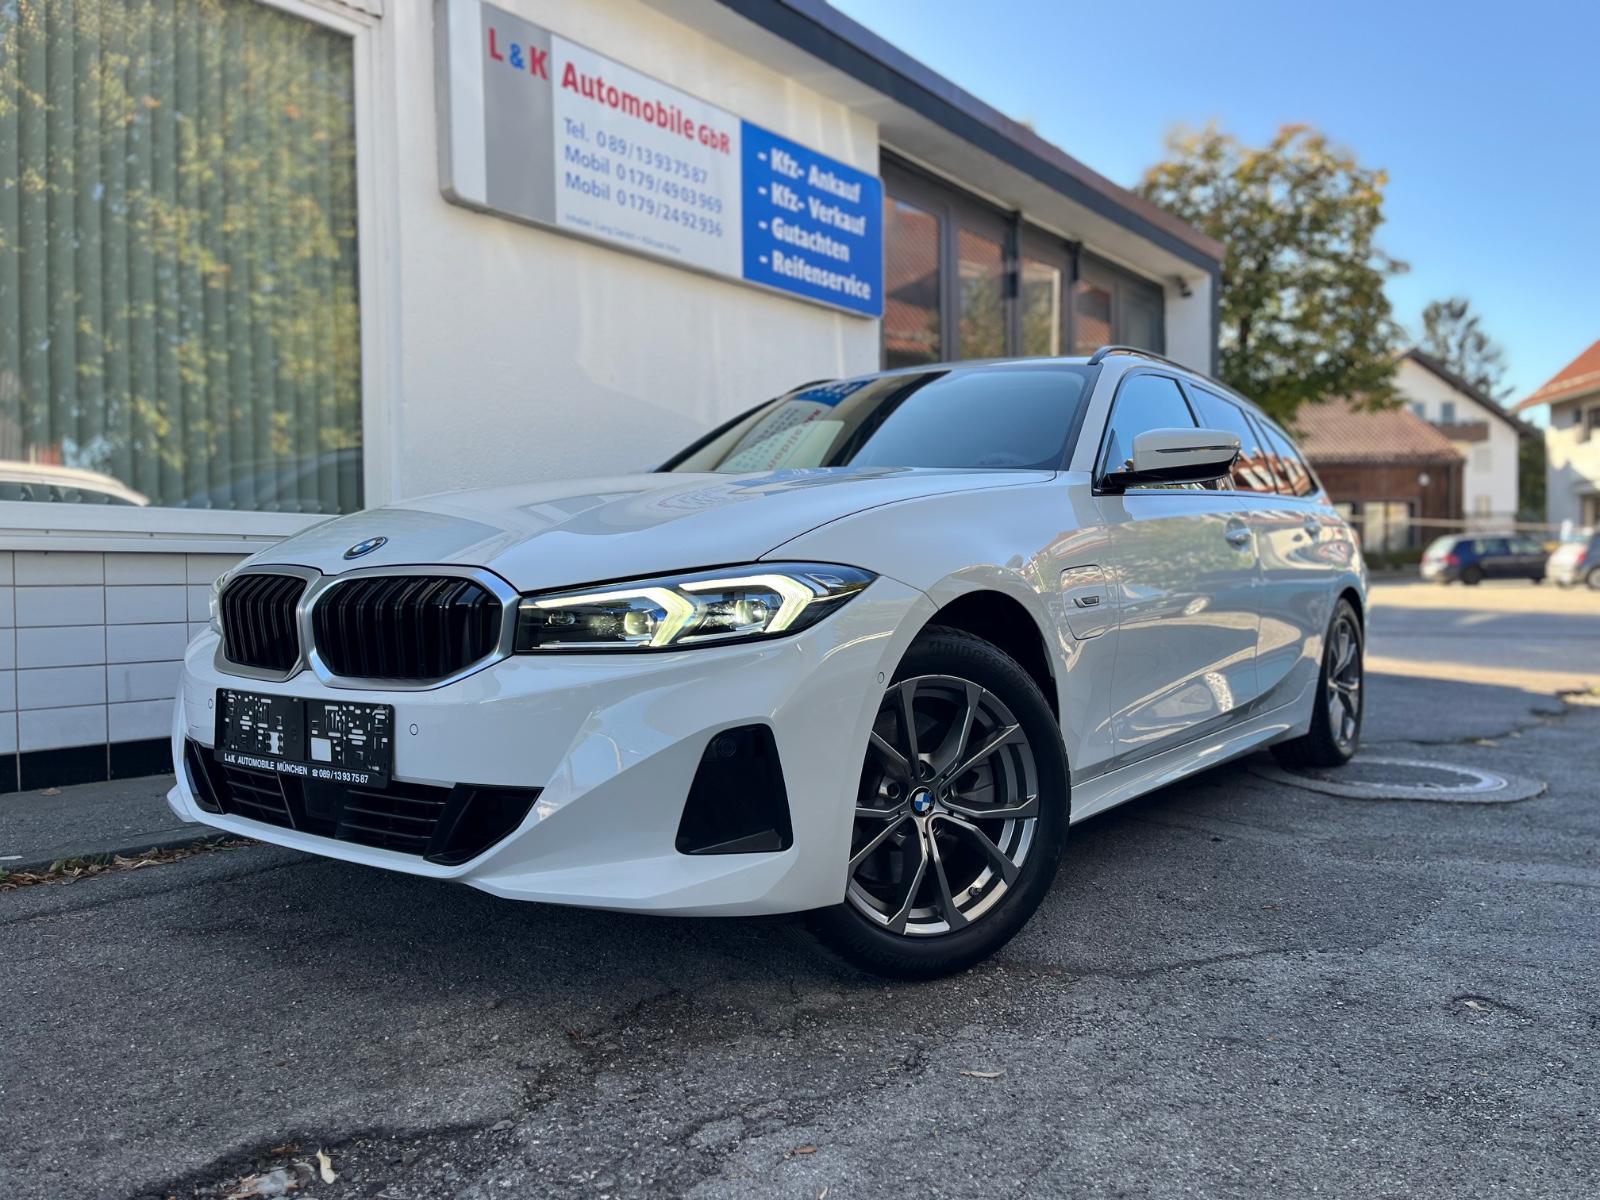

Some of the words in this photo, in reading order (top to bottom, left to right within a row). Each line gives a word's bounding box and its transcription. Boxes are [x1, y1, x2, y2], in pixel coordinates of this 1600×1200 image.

[489, 27, 504, 62] L
[509, 43, 525, 70] &
[529, 46, 548, 81] K
[561, 62, 695, 140] Automobile
[698, 124, 730, 155] GbR
[564, 117, 590, 143] Tel.
[565, 144, 610, 175] Mobil
[565, 171, 610, 200] Mobil
[808, 164, 861, 204] Ankauf
[808, 195, 866, 237] Verkauf
[772, 216, 850, 263] Gutachten
[772, 249, 871, 300] Reifenservice
[238, 756, 275, 770] AUTOMOBILE
[277, 761, 307, 776] MÜNCHEN
